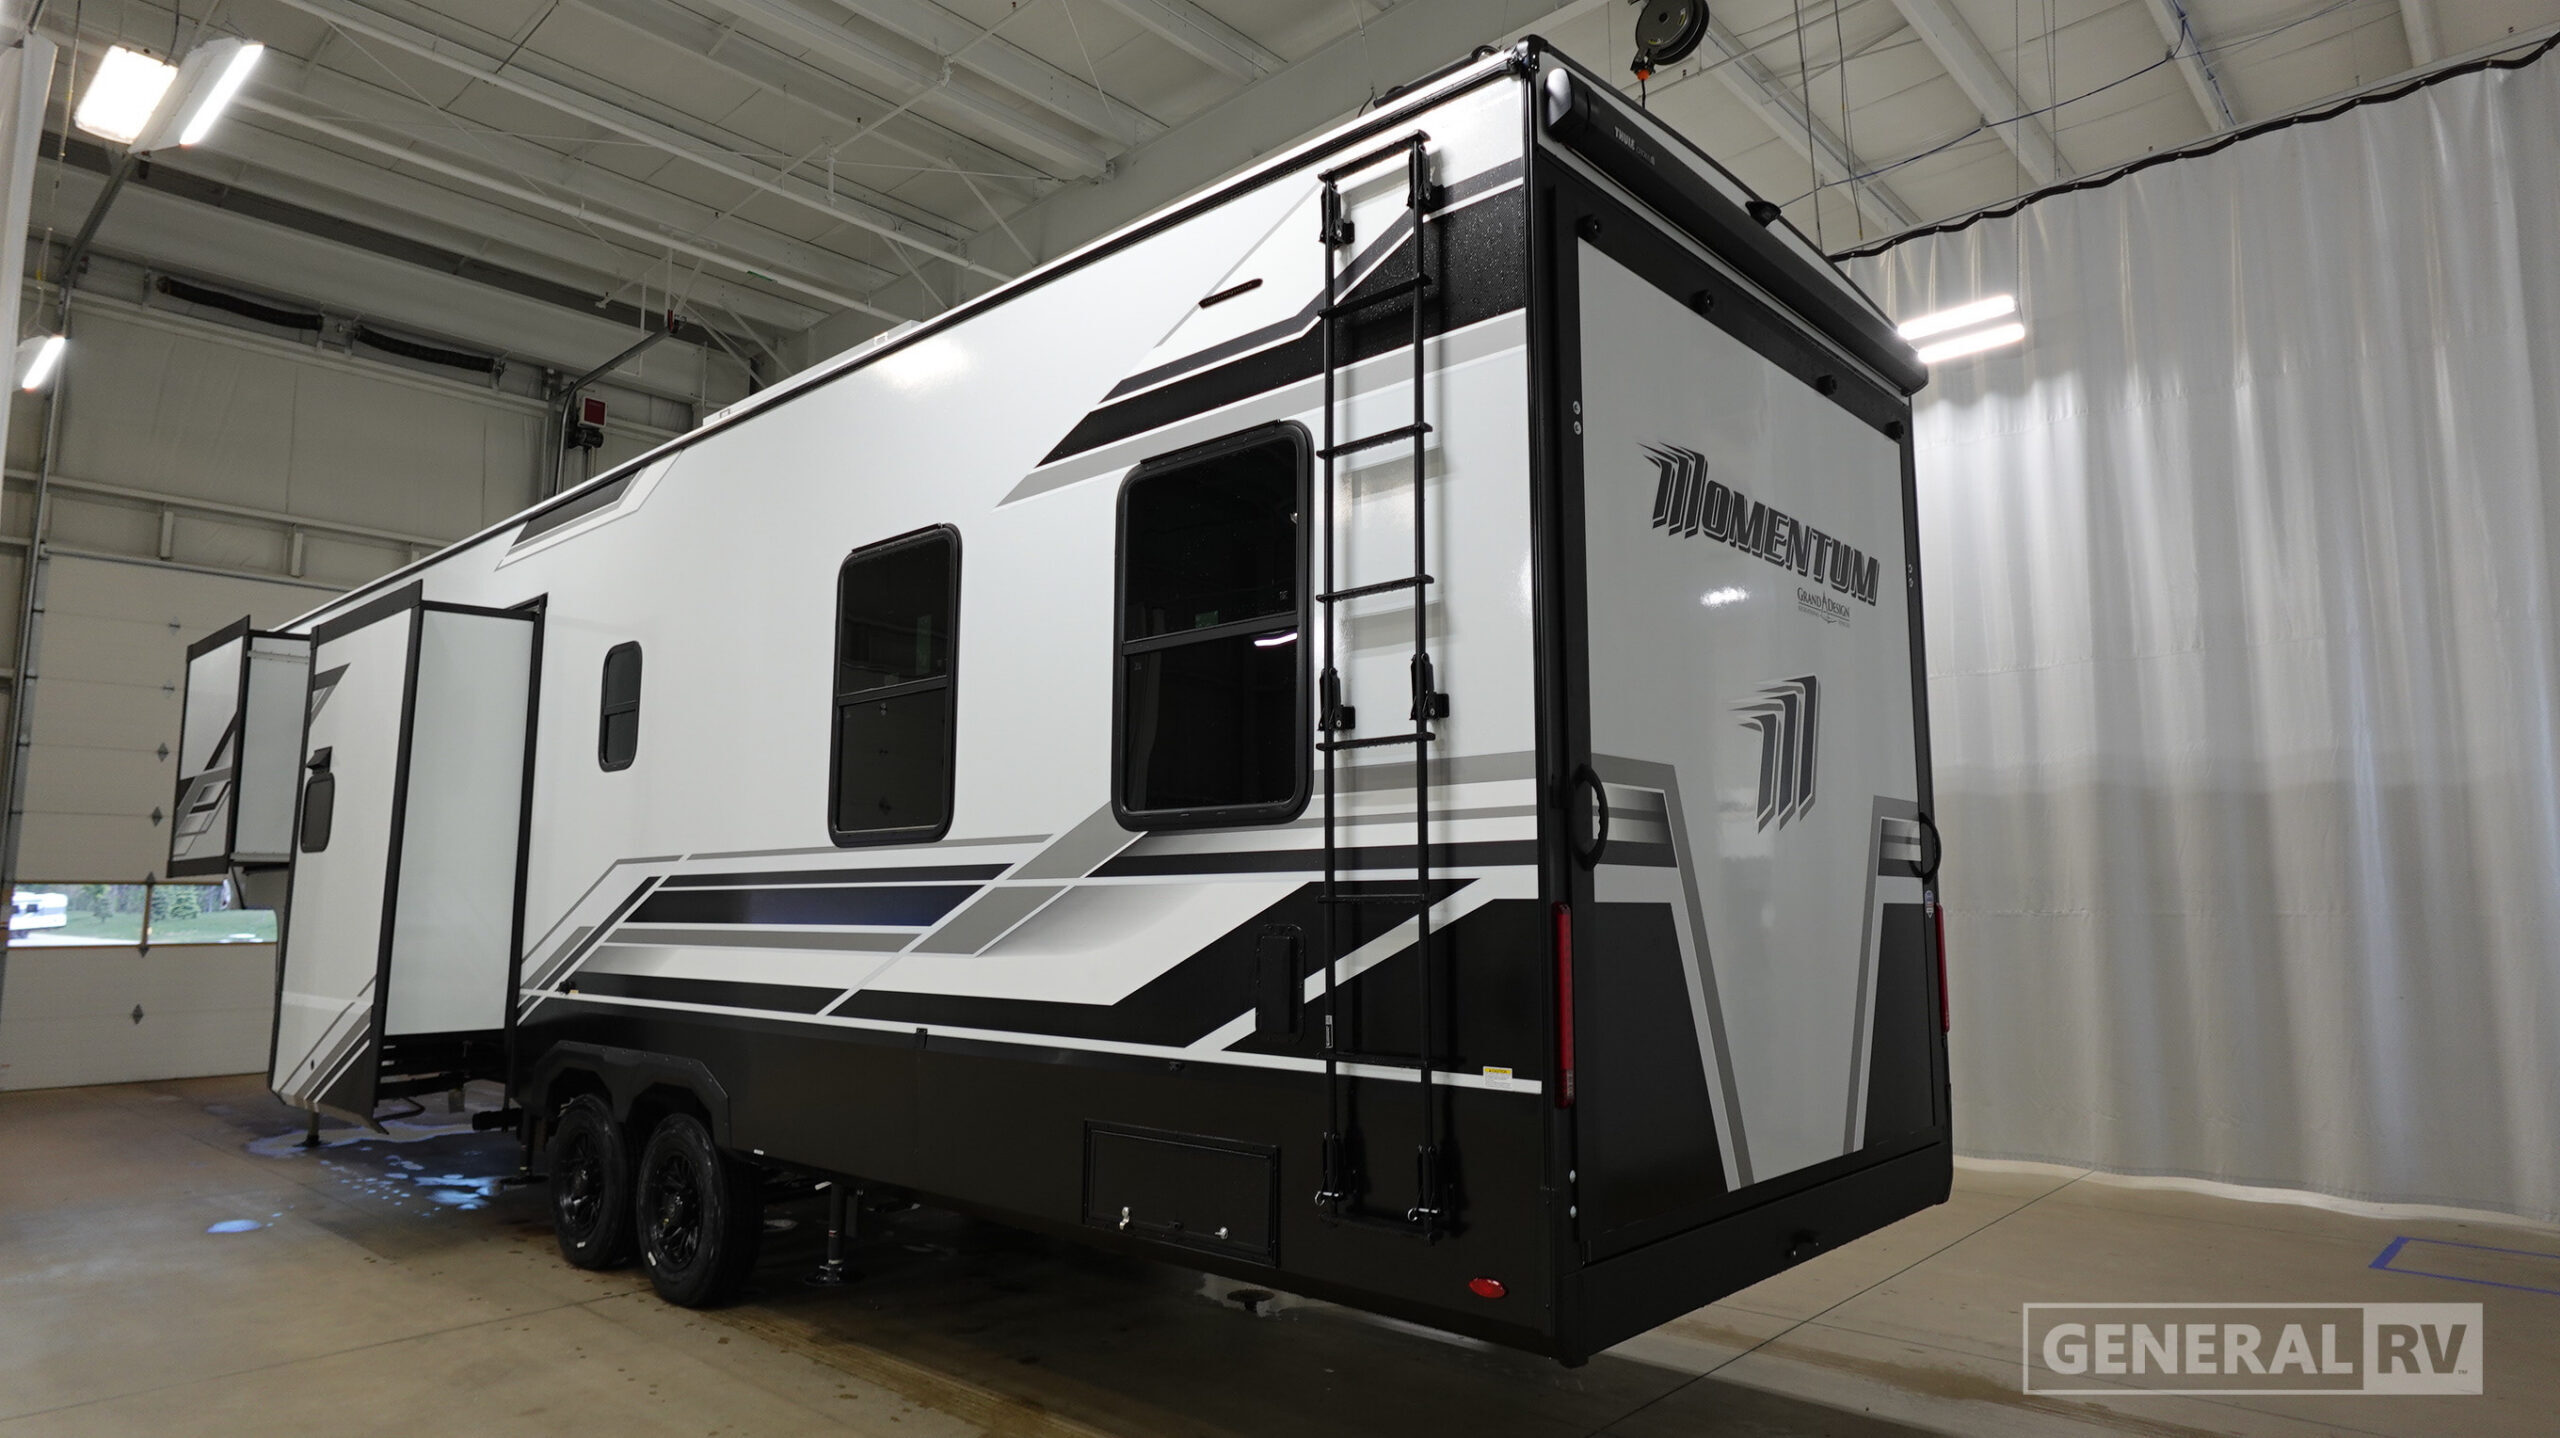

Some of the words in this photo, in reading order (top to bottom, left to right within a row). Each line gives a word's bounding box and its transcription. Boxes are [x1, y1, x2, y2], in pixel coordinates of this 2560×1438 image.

[1614, 125, 1636, 151] THULE
[1637, 441, 1880, 606] MOMENTUM
[1797, 587, 1821, 608] GRAND
[1827, 598, 1850, 618] DESIGN
